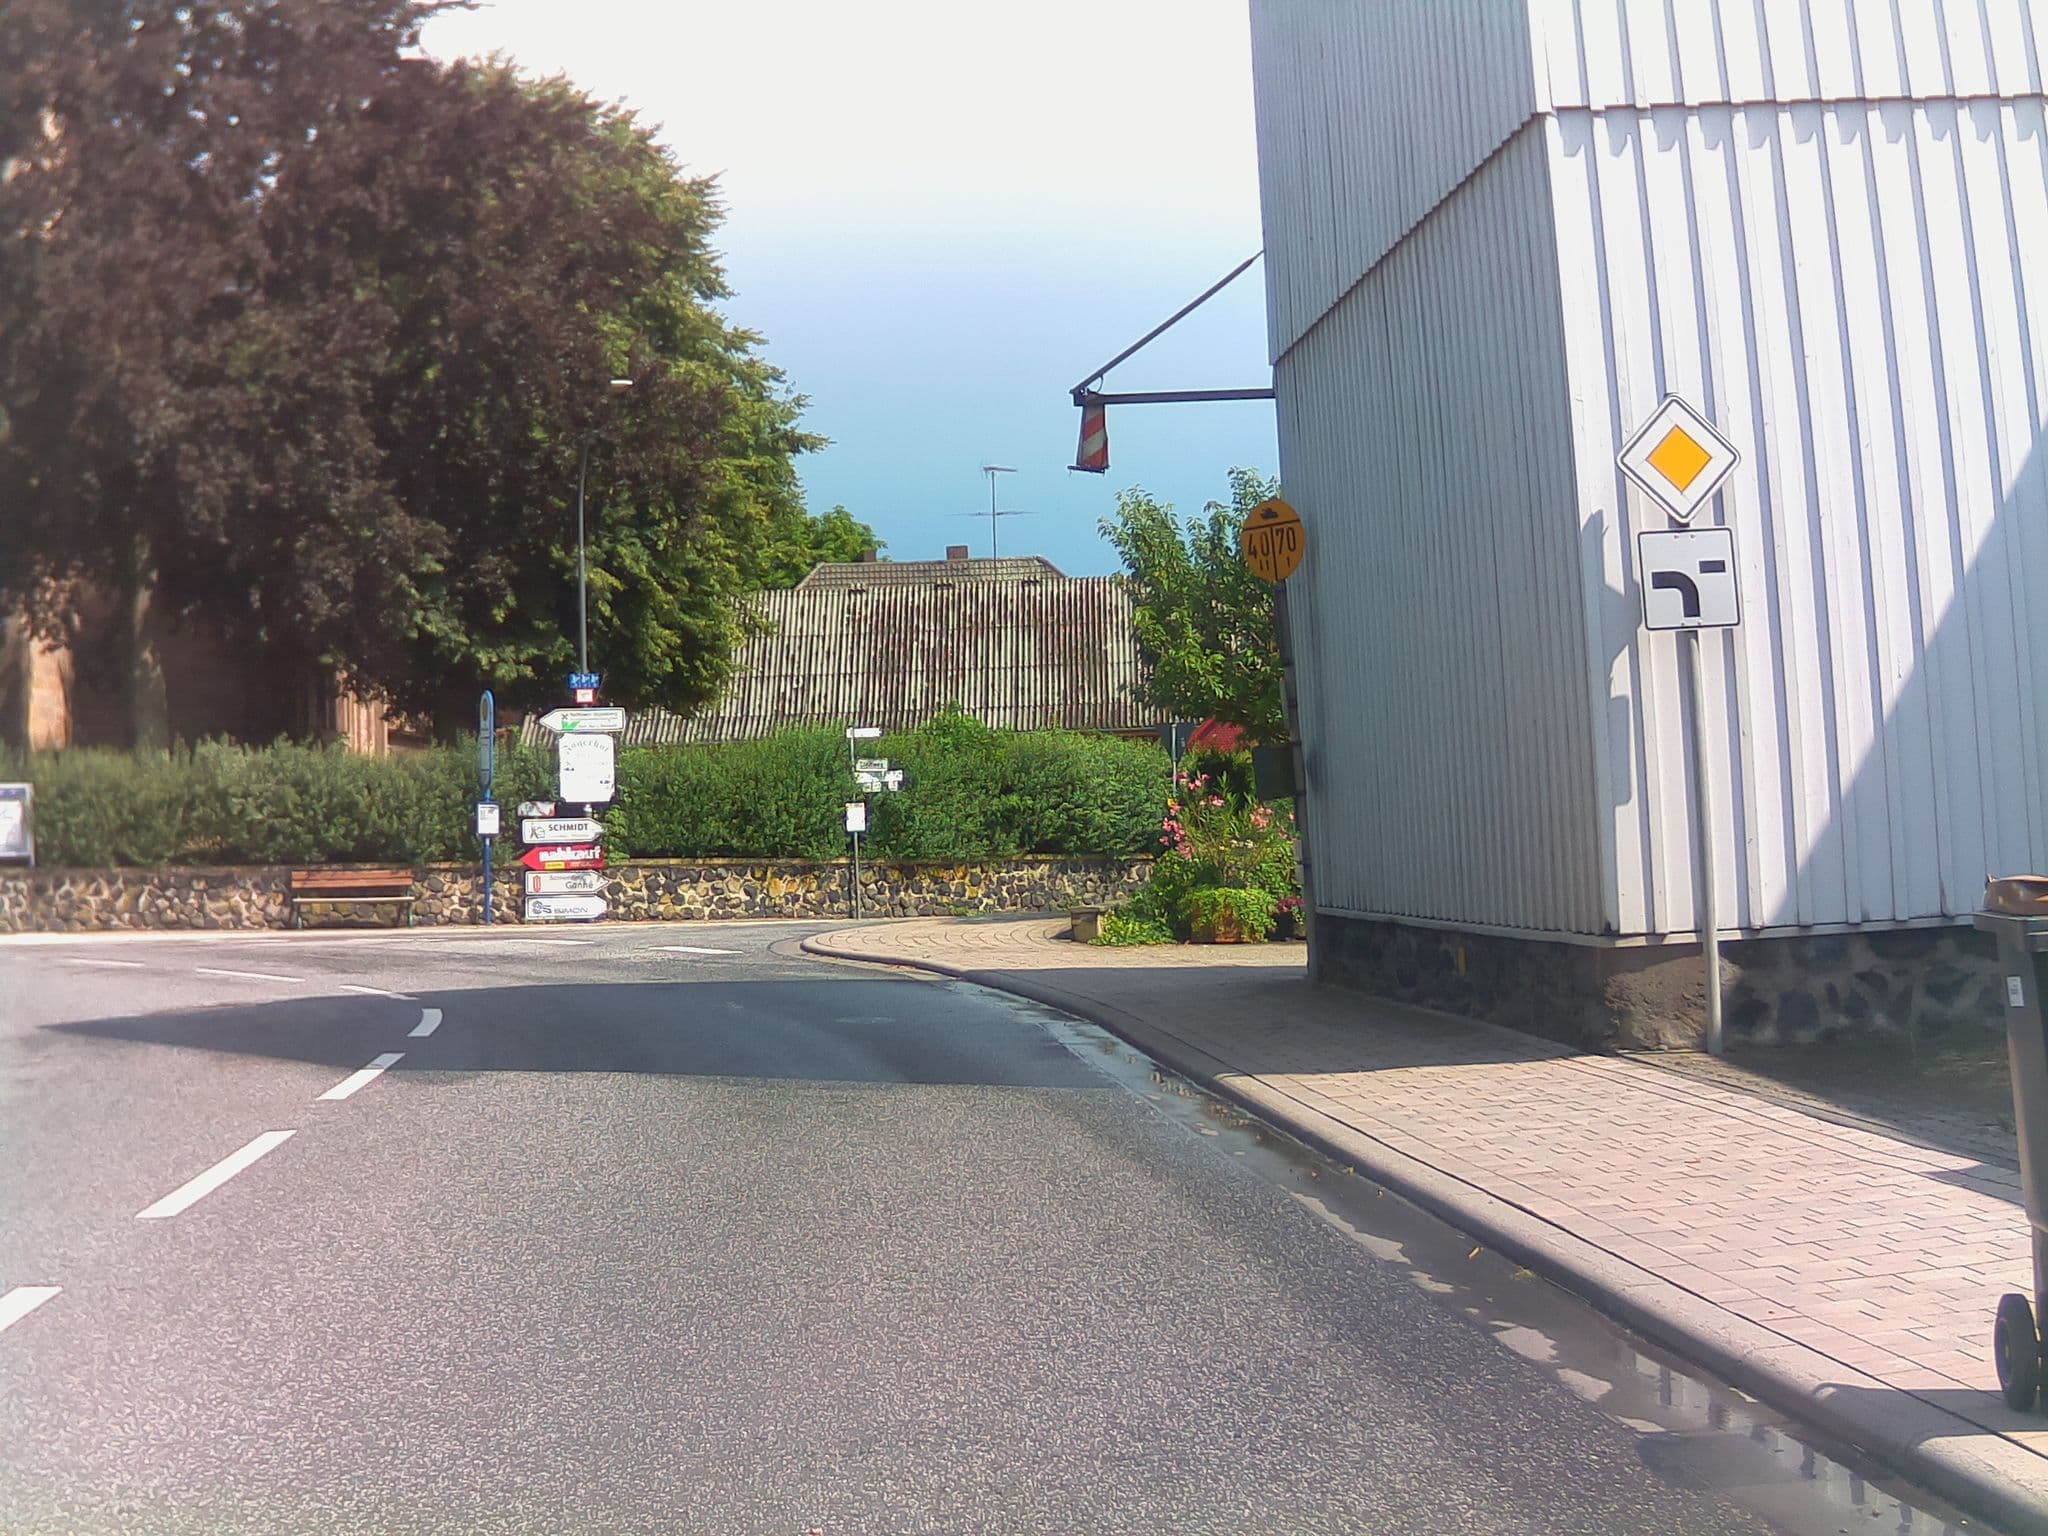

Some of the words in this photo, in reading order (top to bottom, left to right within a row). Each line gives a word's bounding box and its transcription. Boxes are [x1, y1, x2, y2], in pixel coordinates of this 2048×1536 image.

[1247, 531, 1270, 559] 40
[1275, 527, 1296, 555] 70
[548, 823, 589, 832] SCHMIDT
